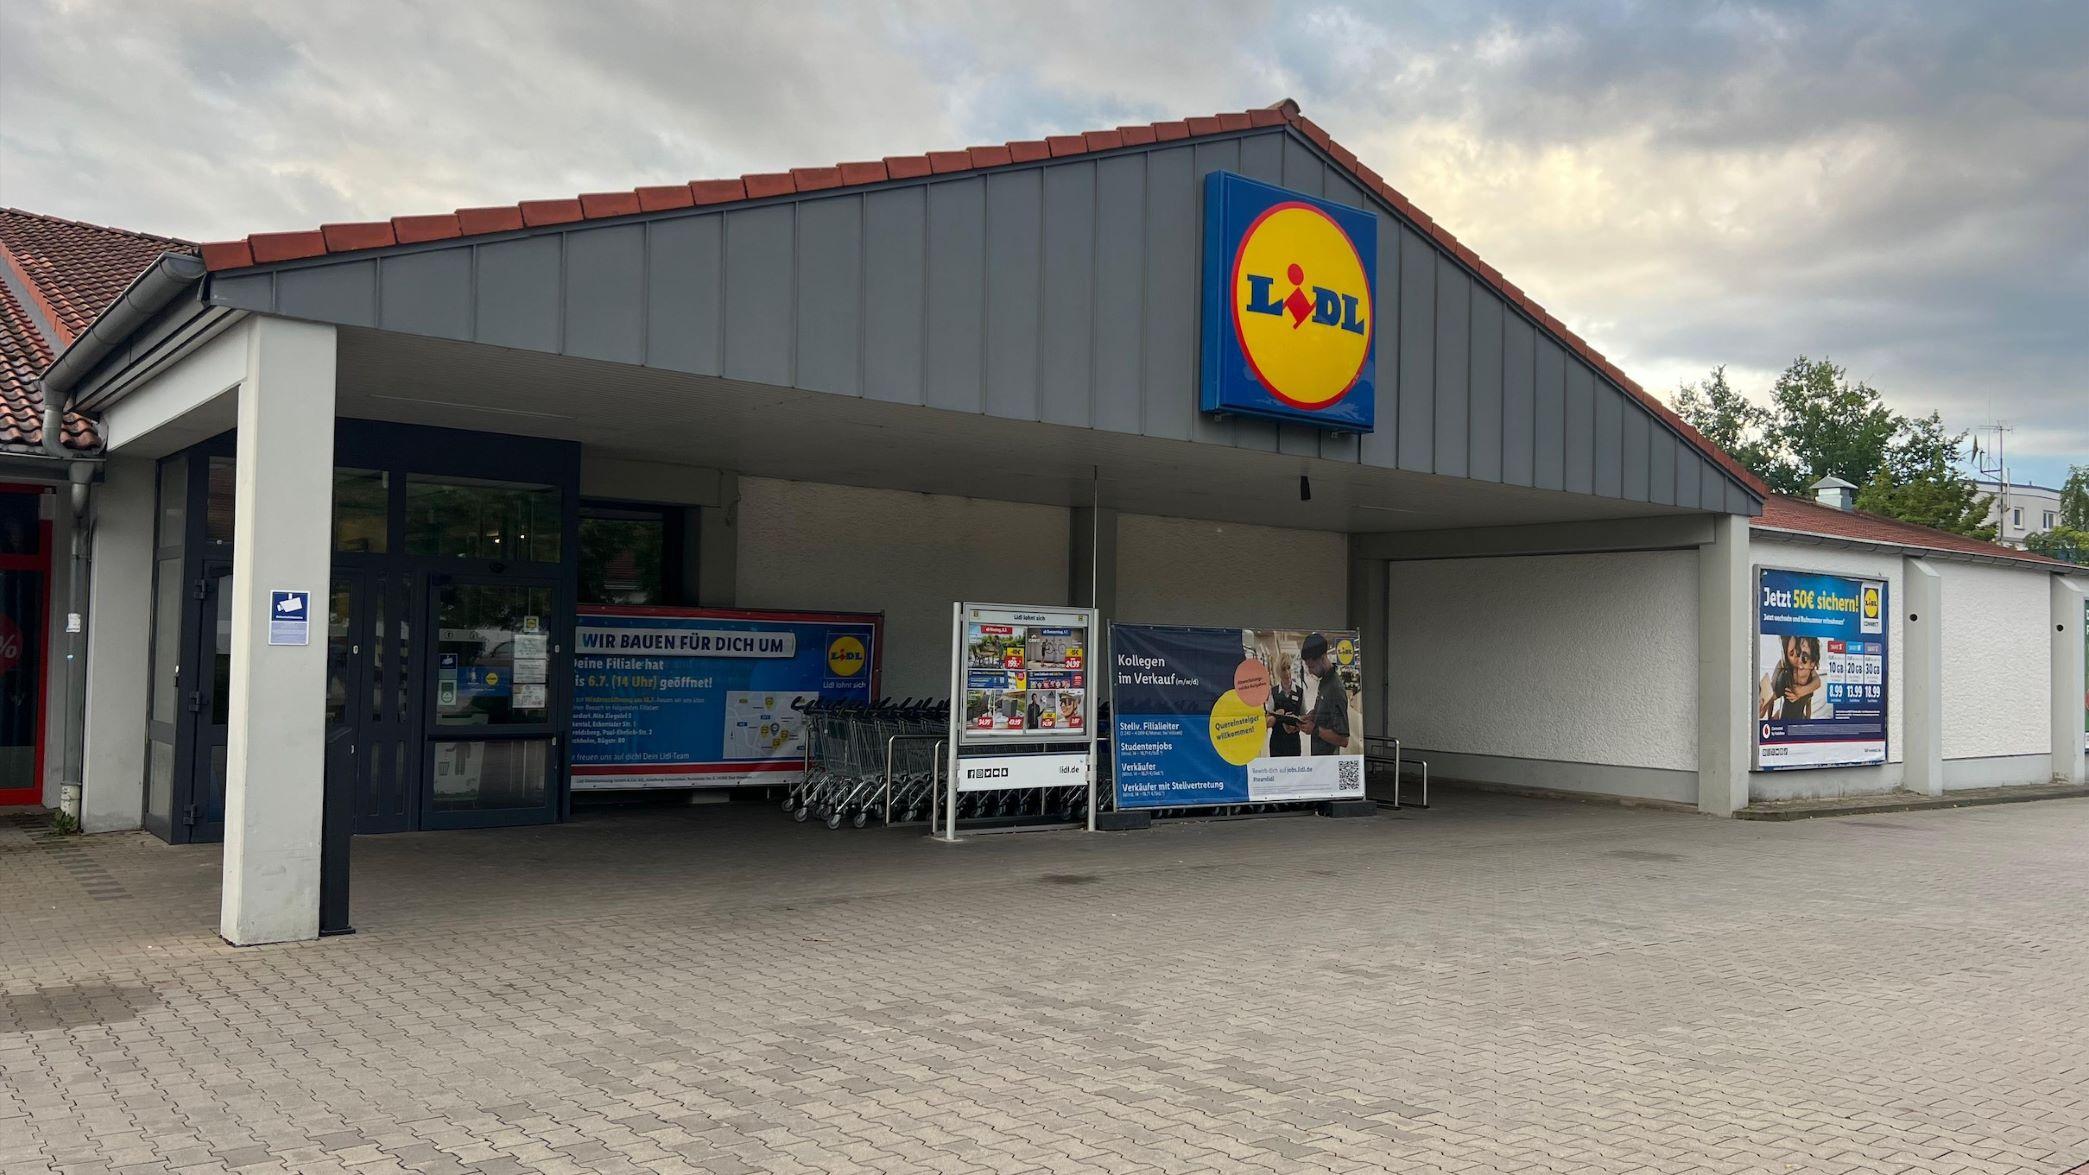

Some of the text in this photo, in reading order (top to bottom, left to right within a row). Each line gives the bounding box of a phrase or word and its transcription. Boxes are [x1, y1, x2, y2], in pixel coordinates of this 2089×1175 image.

[1763, 587, 1859, 613] Jetzt 50€ sichern!
[582, 632, 784, 653] WIR BAUEN FÜR DICH UM
[574, 658, 664, 670] eine Filiale hat
[1117, 654, 1165, 669] Kollegen
[1829, 662, 1844, 674] 10 GB
[1847, 662, 1863, 674] 20 GB
[1866, 663, 1880, 675] 30 GB
[588, 675, 609, 687] 6.7.
[612, 676, 629, 689] (14
[632, 676, 657, 689] Uhr)
[660, 677, 713, 691] geöffnet!
[823, 681, 835, 689] Lidl
[853, 681, 866, 689] sich
[1118, 672, 1200, 686] im Verkauf (m/w/d)
[1829, 684, 1843, 698] 8.99
[1847, 684, 1863, 698] 13.99
[1865, 685, 1881, 698] 18.99
[1120, 722, 1180, 730] Stellv. Filialleiter
[1215, 715, 1259, 731] Quereinsteiger
[1215, 726, 1255, 742] willkommen!
[1120, 741, 1173, 752] Studentenjobs
[1059, 765, 1080, 774] lidl.de
[1121, 762, 1156, 771] Verkäufer
[1122, 780, 1224, 792] Verkäufer mit Stellvertretung
